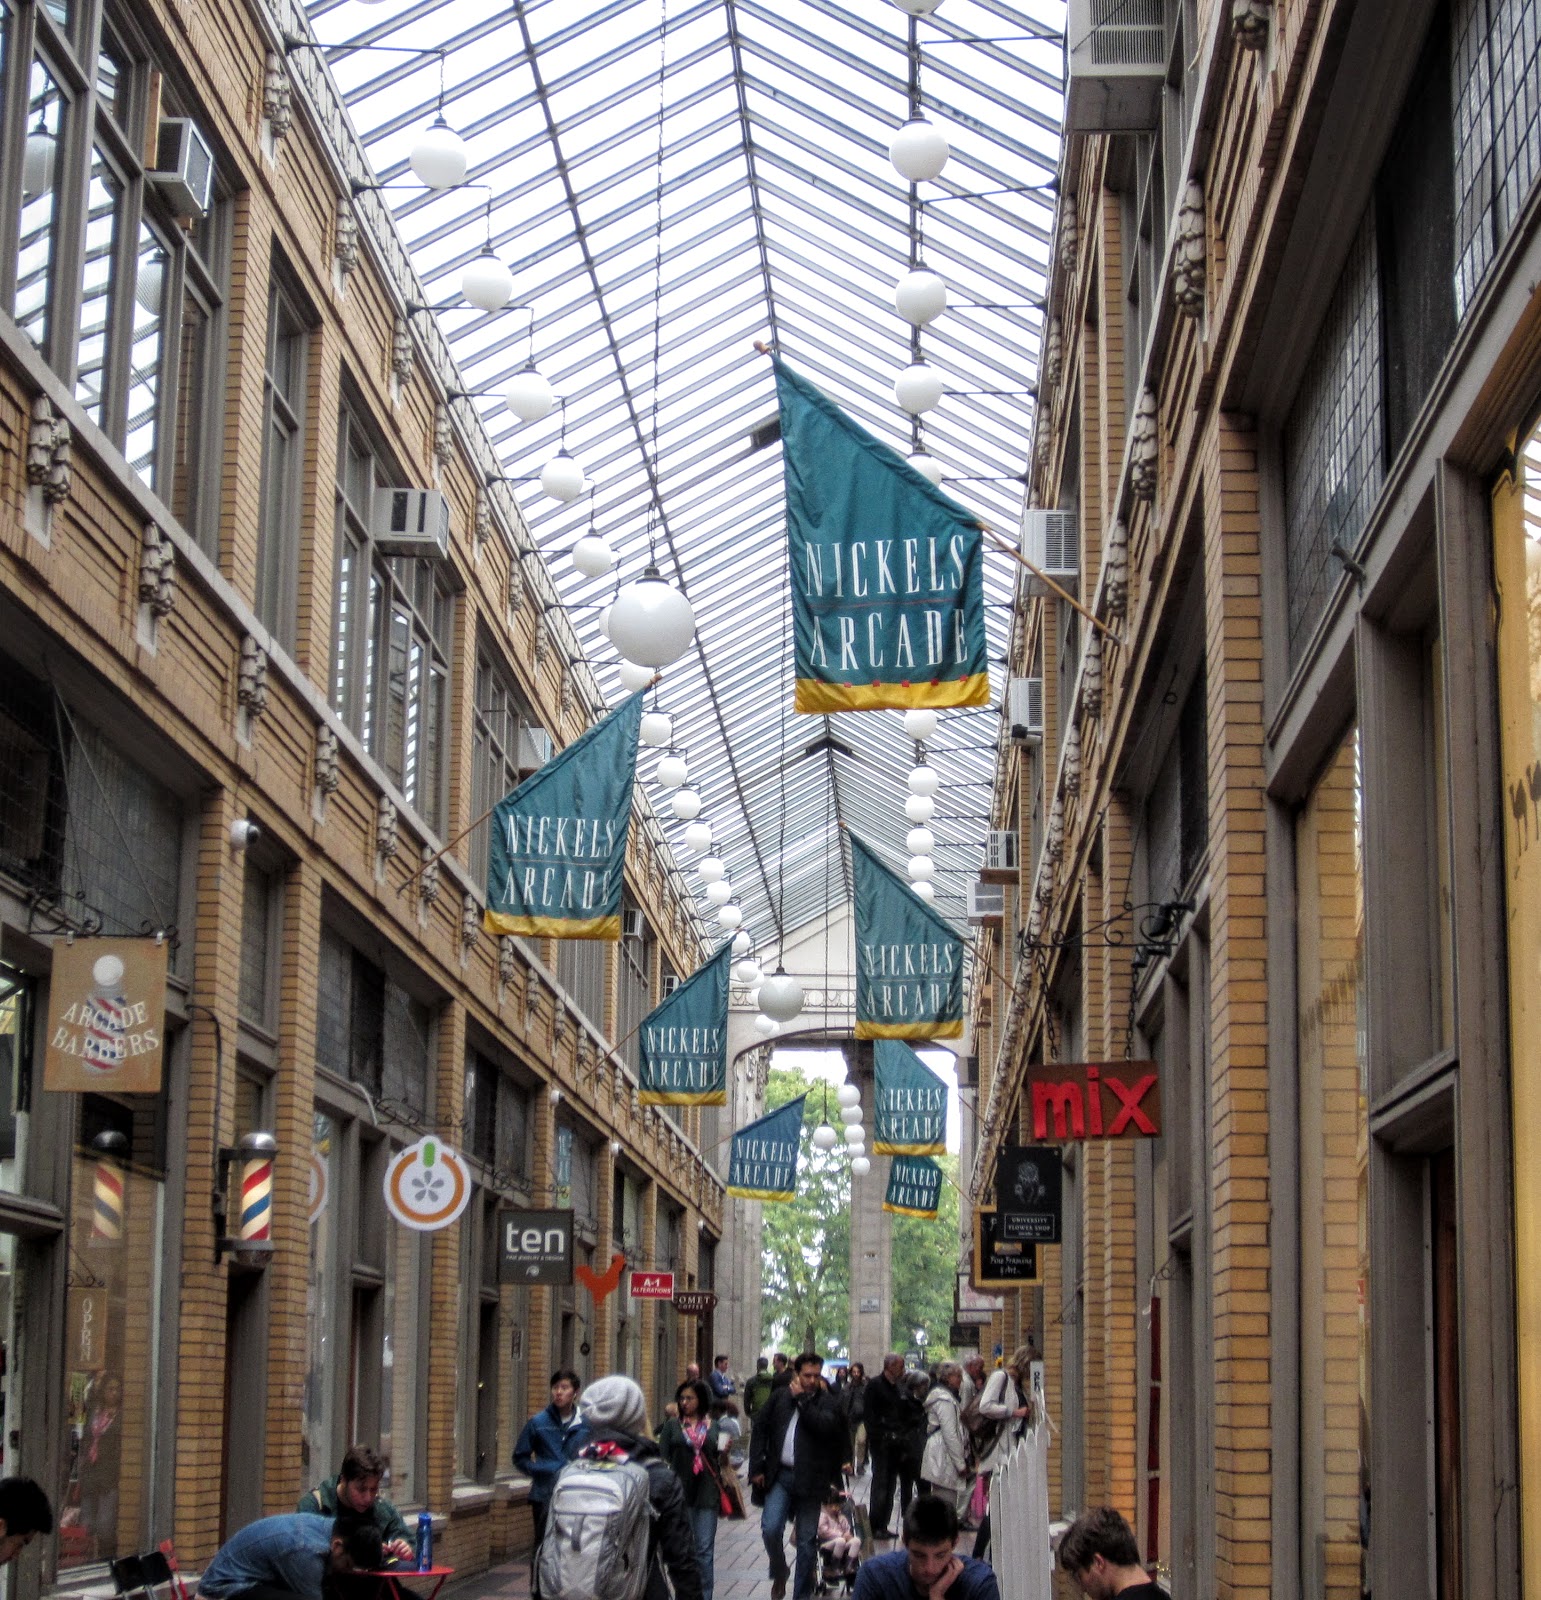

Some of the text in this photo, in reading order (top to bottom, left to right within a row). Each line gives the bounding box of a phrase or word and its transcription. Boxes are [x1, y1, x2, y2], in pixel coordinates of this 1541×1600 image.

[805, 534, 965, 598] NICKELS
[810, 608, 968, 671] ARCADE
[506, 814, 615, 858] NICKELS
[501, 866, 612, 910] ARCADE
[865, 943, 953, 976] NICKELS
[866, 983, 954, 1017] ARCADE
[60, 1001, 148, 1031] ARCADE
[50, 1026, 160, 1060] BARBERS
[647, 1027, 720, 1054] NICKELS
[647, 1060, 719, 1087] ARCADE
[880, 1088, 942, 1112] NICKELS
[1031, 1066, 1158, 1139] mix
[880, 1116, 942, 1140] ARCADE
[735, 1138, 793, 1164] NICKELS
[733, 1163, 791, 1188] ARCADE
[894, 1164, 939, 1188] NICKELS
[889, 1184, 936, 1209] ARCADE
[506, 1222, 564, 1253] ten
[643, 1278, 660, 1288] A-1
[672, 1296, 710, 1305] COMET
[81, 1298, 92, 1361] OPEN
